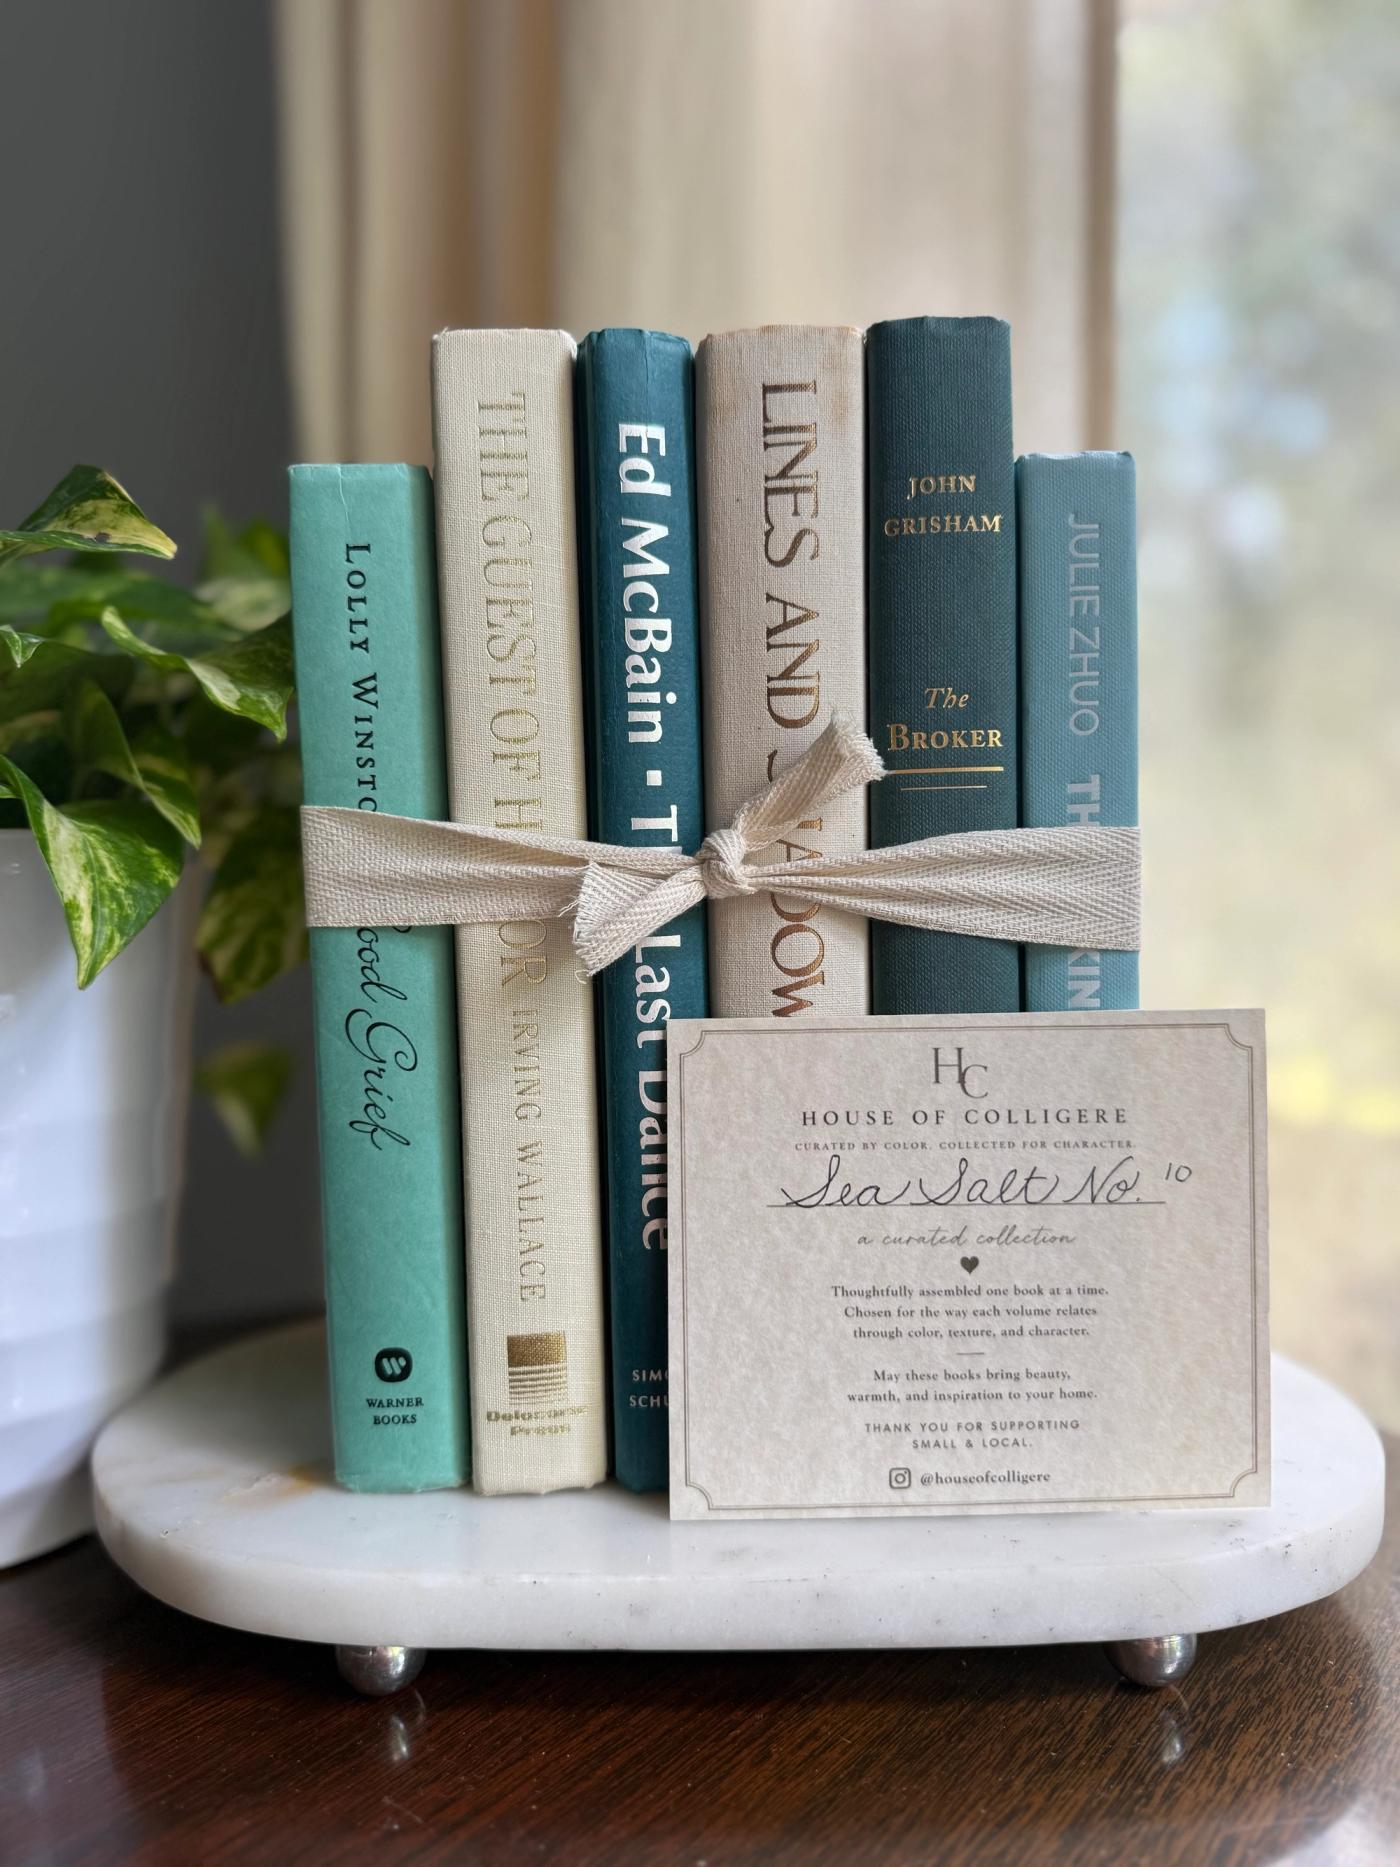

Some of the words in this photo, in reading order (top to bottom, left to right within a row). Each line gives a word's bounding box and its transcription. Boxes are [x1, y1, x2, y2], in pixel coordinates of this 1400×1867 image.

[478, 391, 530, 501] THE
[618, 423, 671, 497] Ed
[762, 380, 819, 568] LINES
[907, 474, 977, 500] JOHN
[884, 514, 1002, 537] GRISHAM
[1069, 513, 1100, 617] JULIE
[344, 543, 371, 654] LOLLY
[482, 515, 537, 696] GUEST
[622, 516, 677, 744] McBain
[766, 592, 820, 730] AND
[1069, 626, 1100, 736] ZHUO
[924, 687, 969, 710] The
[490, 708, 541, 782] OF
[887, 723, 1004, 752] BROKER
[512, 1008, 541, 1121] IRVING
[345, 1008, 418, 1151] Grief
[801, 1109, 895, 1127] HOUSE
[911, 1109, 946, 1126] OF
[963, 1107, 1127, 1125] COLLIGERE
[794, 1142, 855, 1152] CURATED
[861, 1141, 878, 1151] BY
[938, 1140, 1016, 1151] COLLECTED
[1022, 1140, 1048, 1150] FOR
[1053, 1139, 1136, 1150] CHARACTER.
[780, 1154, 912, 1208] Sea
[910, 1157, 1060, 1206] Salt
[1062, 1155, 1143, 1204] No.
[1165, 1163, 1193, 1183] 10
[516, 1140, 546, 1301] WALLACE
[856, 1234, 874, 1246] a
[881, 1225, 970, 1248] curated
[976, 1224, 1077, 1247] collection
[830, 1284, 914, 1300] Thoughtfully
[918, 1284, 982, 1298] assembled
[985, 1287, 1009, 1297] one
[1013, 1283, 1045, 1297] book
[1048, 1286, 1062, 1297] at
[1065, 1287, 1073, 1297] a
[1076, 1284, 1109, 1296] time.
[843, 1305, 892, 1319] Chosen
[896, 1305, 916, 1318] for
[919, 1305, 941, 1319] the
[944, 1308, 968, 1320] way
[971, 1304, 1001, 1319] each
[1005, 1304, 1052, 1318] volume
[853, 1326, 904, 1342] through
[907, 1325, 944, 1340] color,
[947, 1327, 997, 1340] texture,
[1000, 1324, 1025, 1338] and
[1028, 1324, 1090, 1338] character.
[873, 1369, 901, 1384] May
[904, 1368, 939, 1382] these
[943, 1368, 982, 1382] books
[985, 1367, 1021, 1383] bring
[1025, 1367, 1071, 1382] beauty,
[366, 1397, 424, 1408] WARNER
[846, 1389, 901, 1404] warmth,
[905, 1389, 930, 1403] and
[933, 1388, 1004, 1404] inspiration
[1007, 1390, 1022, 1402] to
[1025, 1391, 1055, 1403] your
[1058, 1386, 1098, 1401] home.
[373, 1414, 417, 1425] BOOKS
[864, 1422, 912, 1434] THANK
[919, 1421, 949, 1434] YOU
[956, 1421, 984, 1433] FOR
[990, 1419, 1080, 1432] SUPPORTING
[912, 1439, 957, 1451] SMALL
[964, 1438, 974, 1449] &
[981, 1437, 1033, 1449] LOCAL.
[919, 1469, 1051, 1487] @houseofcolligere
